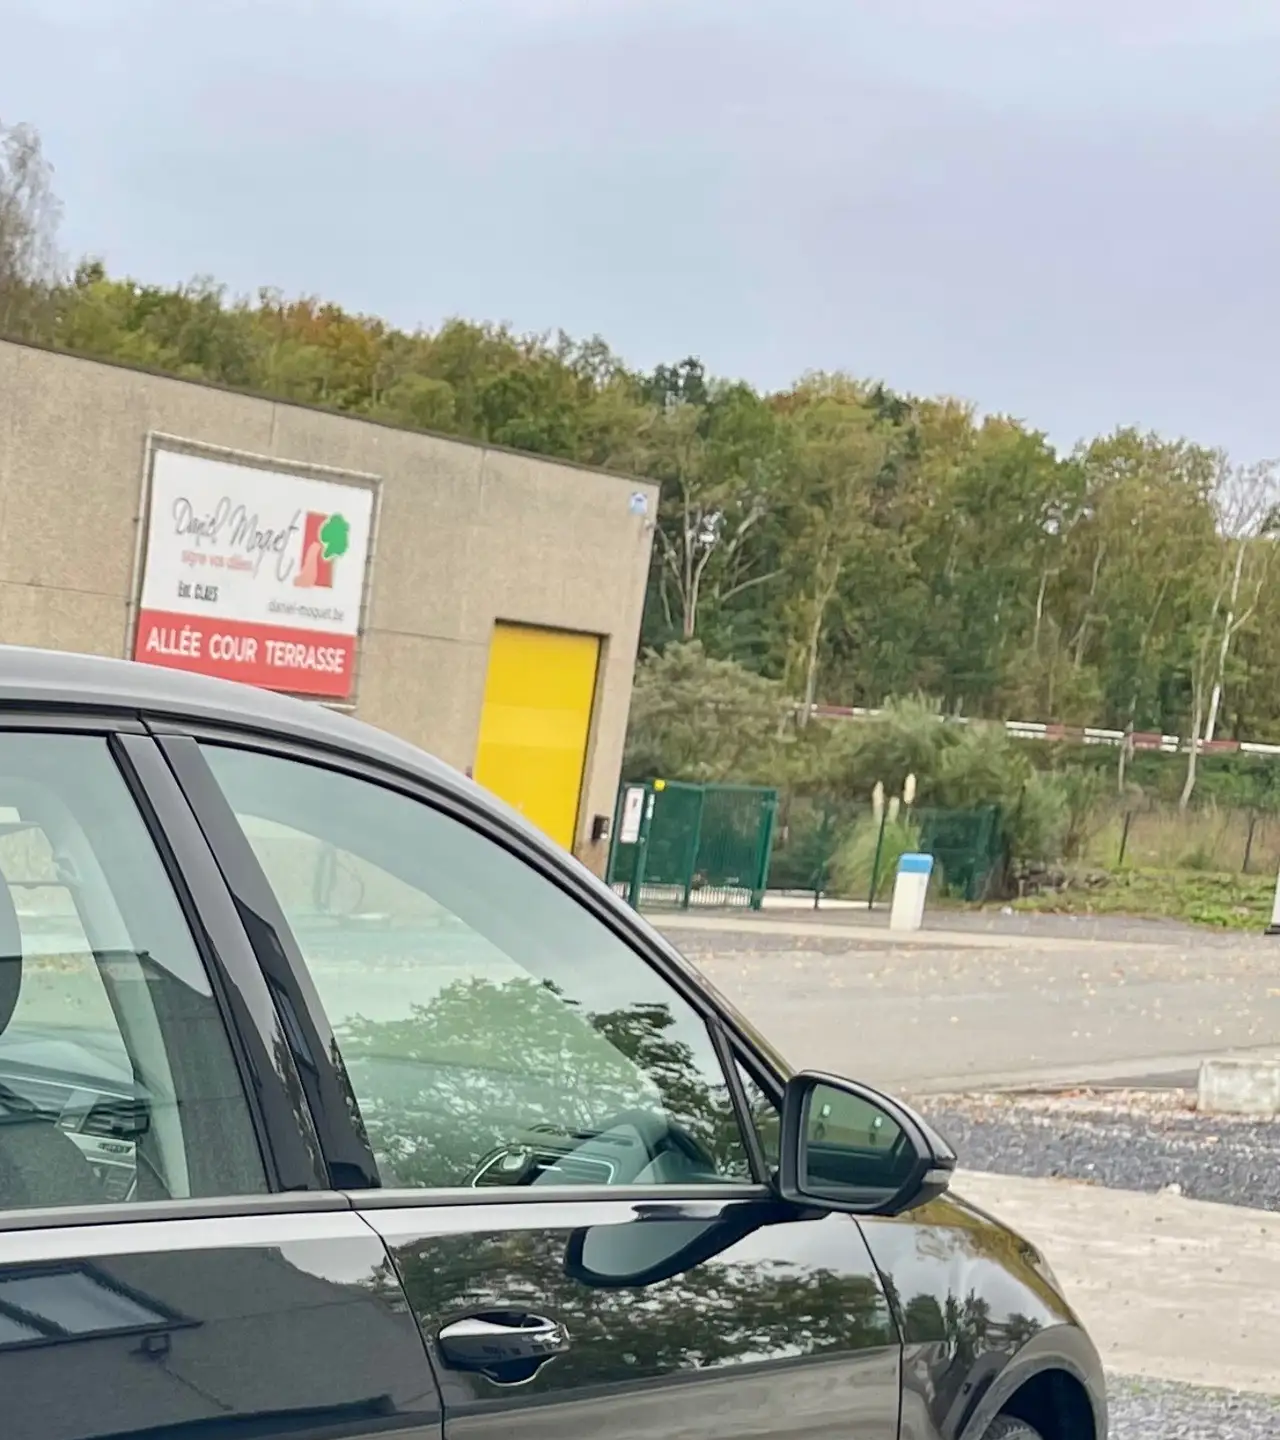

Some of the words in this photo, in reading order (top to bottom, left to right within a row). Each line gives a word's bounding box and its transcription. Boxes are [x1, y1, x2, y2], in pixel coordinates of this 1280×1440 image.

[145, 625, 202, 657] ALLÉE
[209, 633, 257, 664] COUR
[265, 640, 346, 674] TERRASSE
